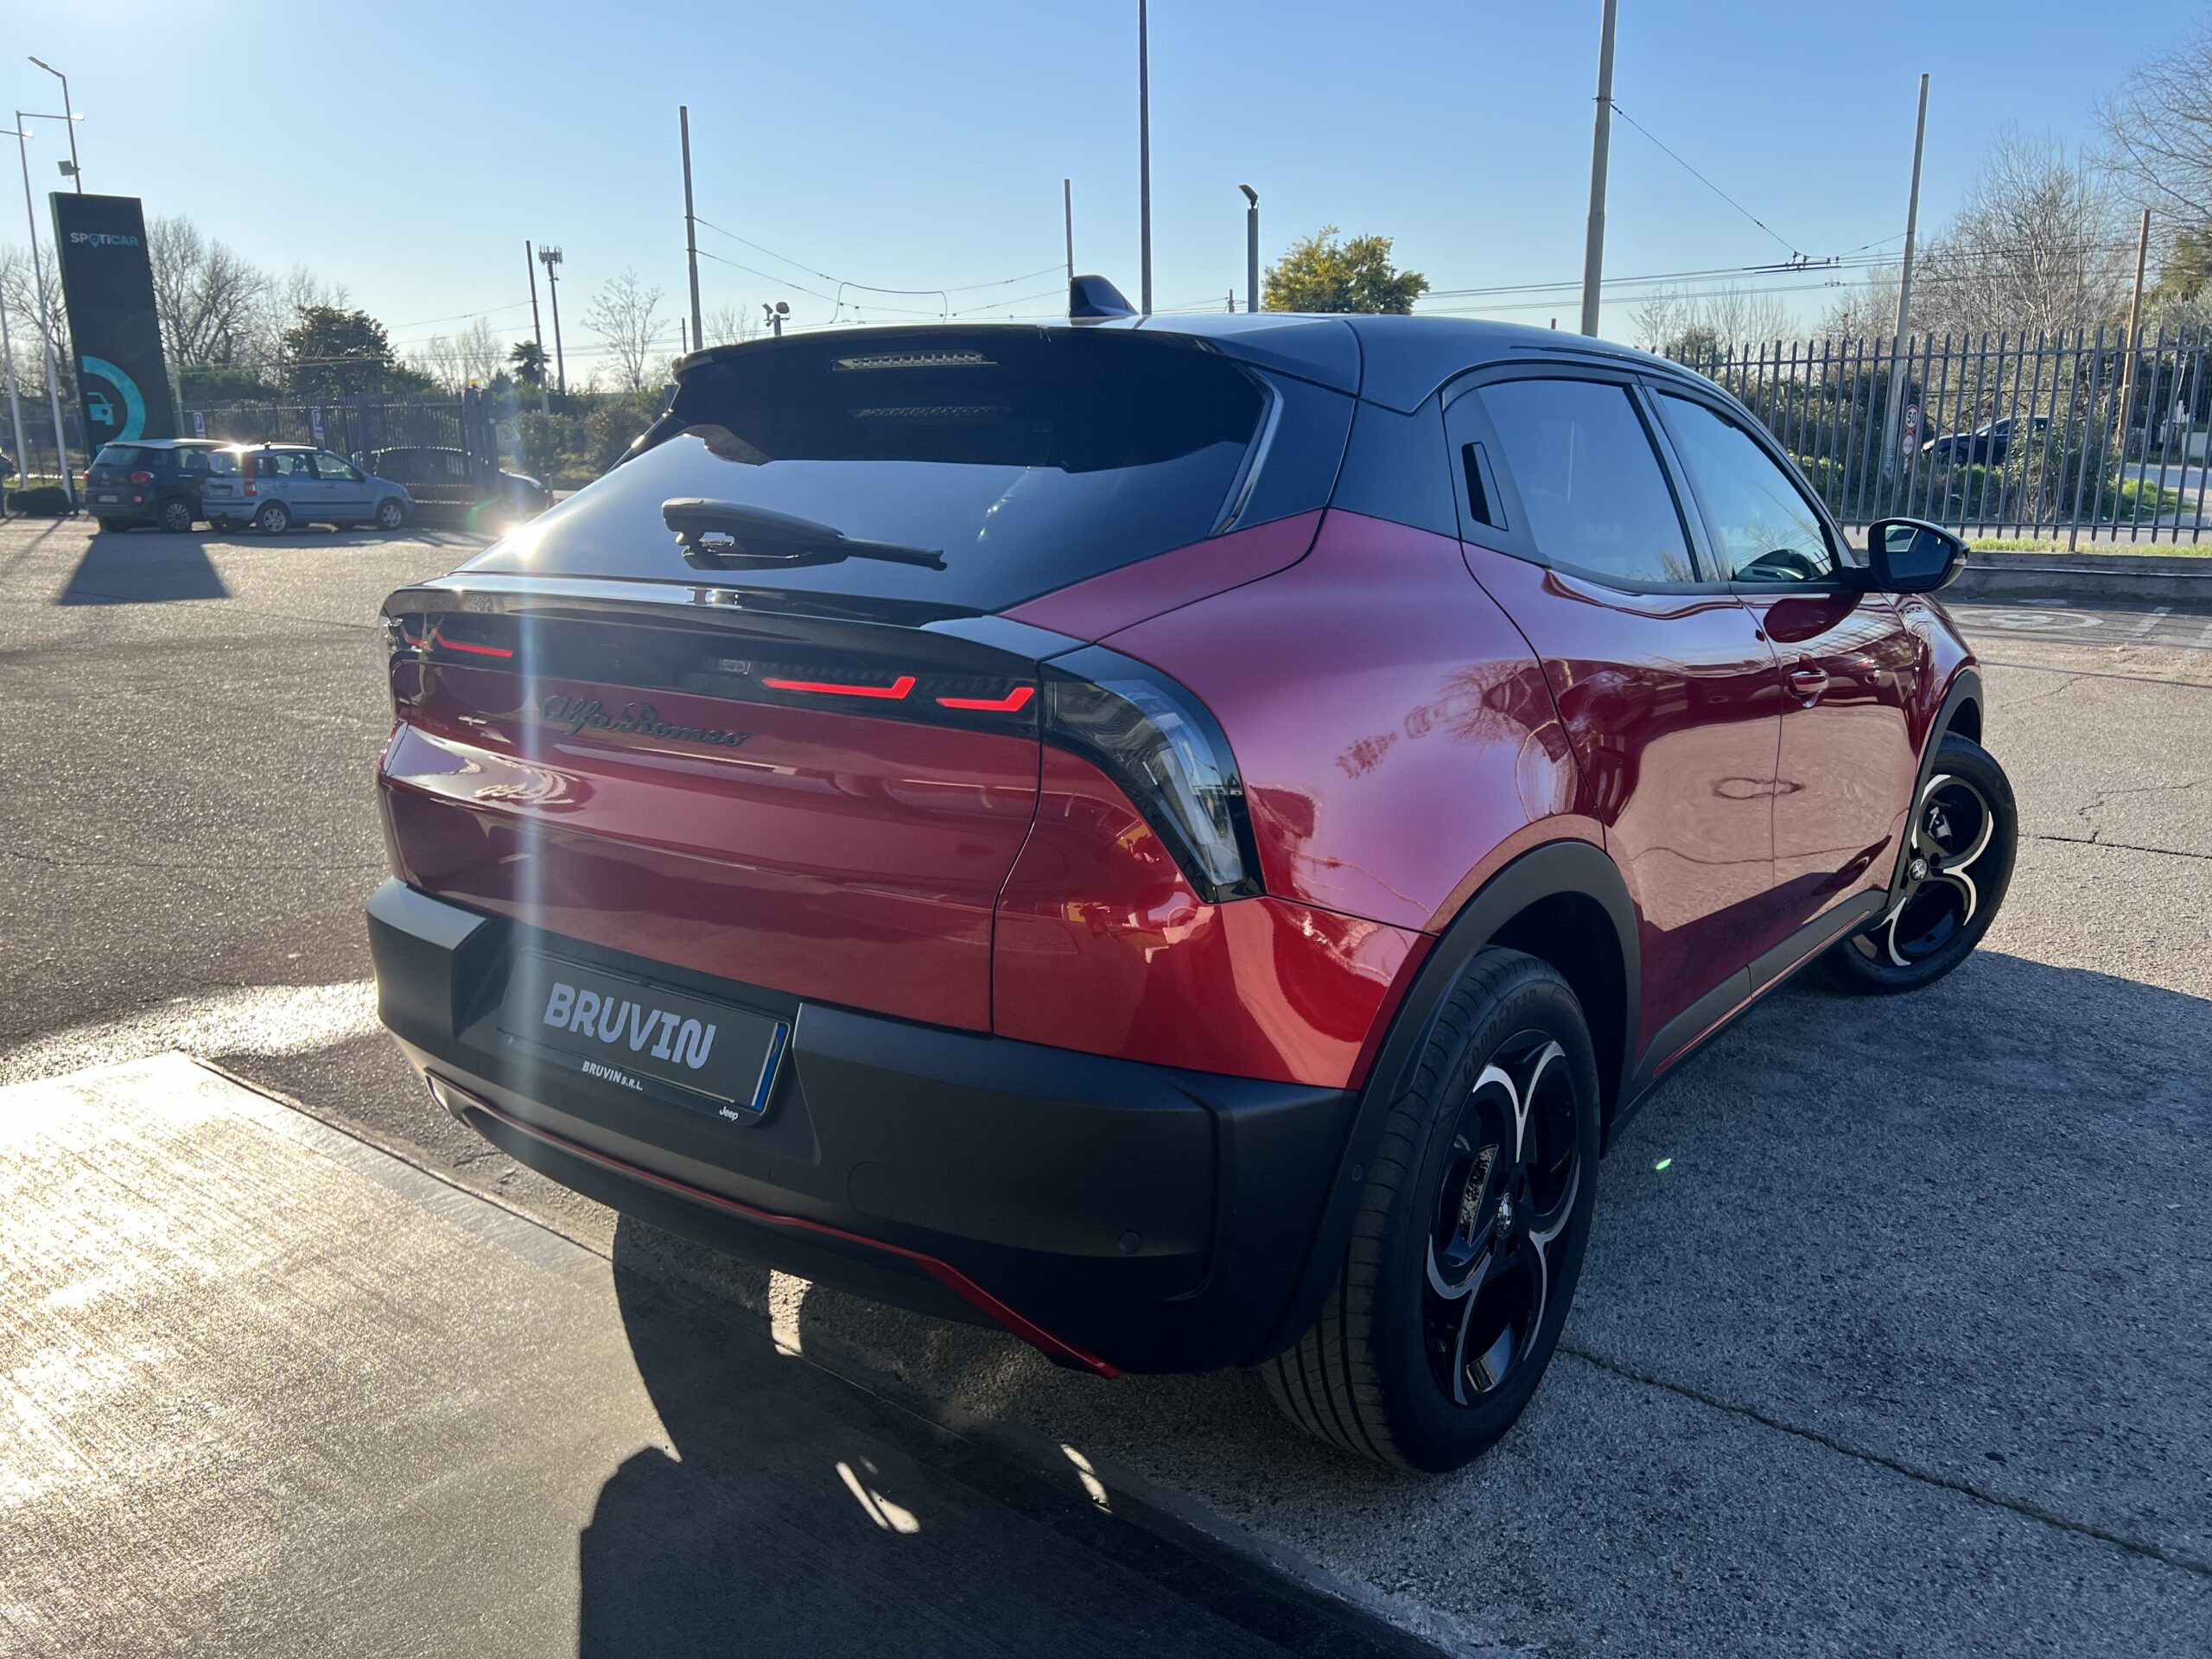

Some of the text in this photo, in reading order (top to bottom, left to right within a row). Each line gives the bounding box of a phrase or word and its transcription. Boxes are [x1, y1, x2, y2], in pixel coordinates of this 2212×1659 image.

[1907, 411, 1916, 423] 50
[539, 695, 751, 747] Alfa Romeo
[543, 982, 717, 1070] BRUVIN
[582, 1060, 622, 1084] BRUVIN
[719, 1106, 739, 1122] Jeep
